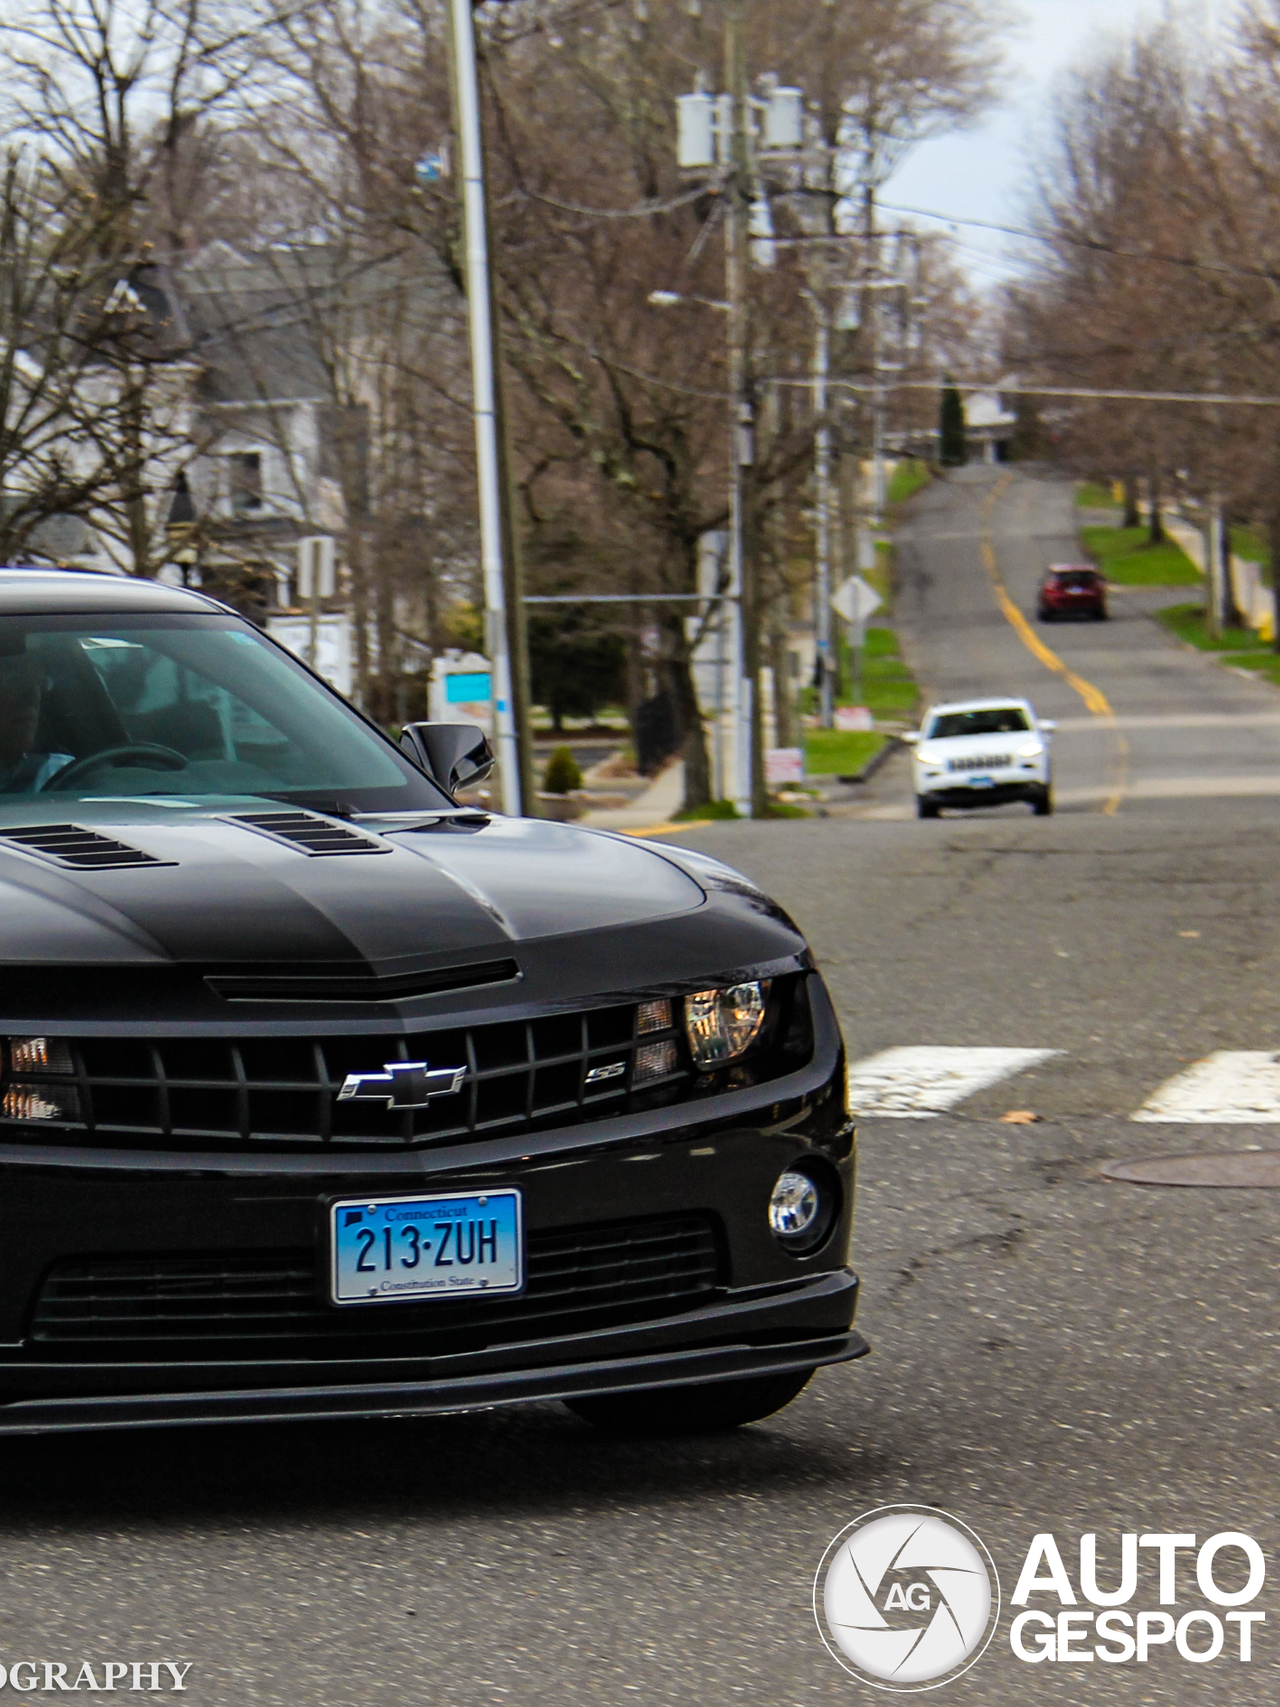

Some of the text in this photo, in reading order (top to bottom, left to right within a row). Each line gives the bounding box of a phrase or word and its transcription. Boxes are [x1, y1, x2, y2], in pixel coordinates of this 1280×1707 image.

[586, 1061, 626, 1083] SS
[385, 1205, 468, 1222] Connecticut
[380, 1275, 475, 1292] Constitution State
